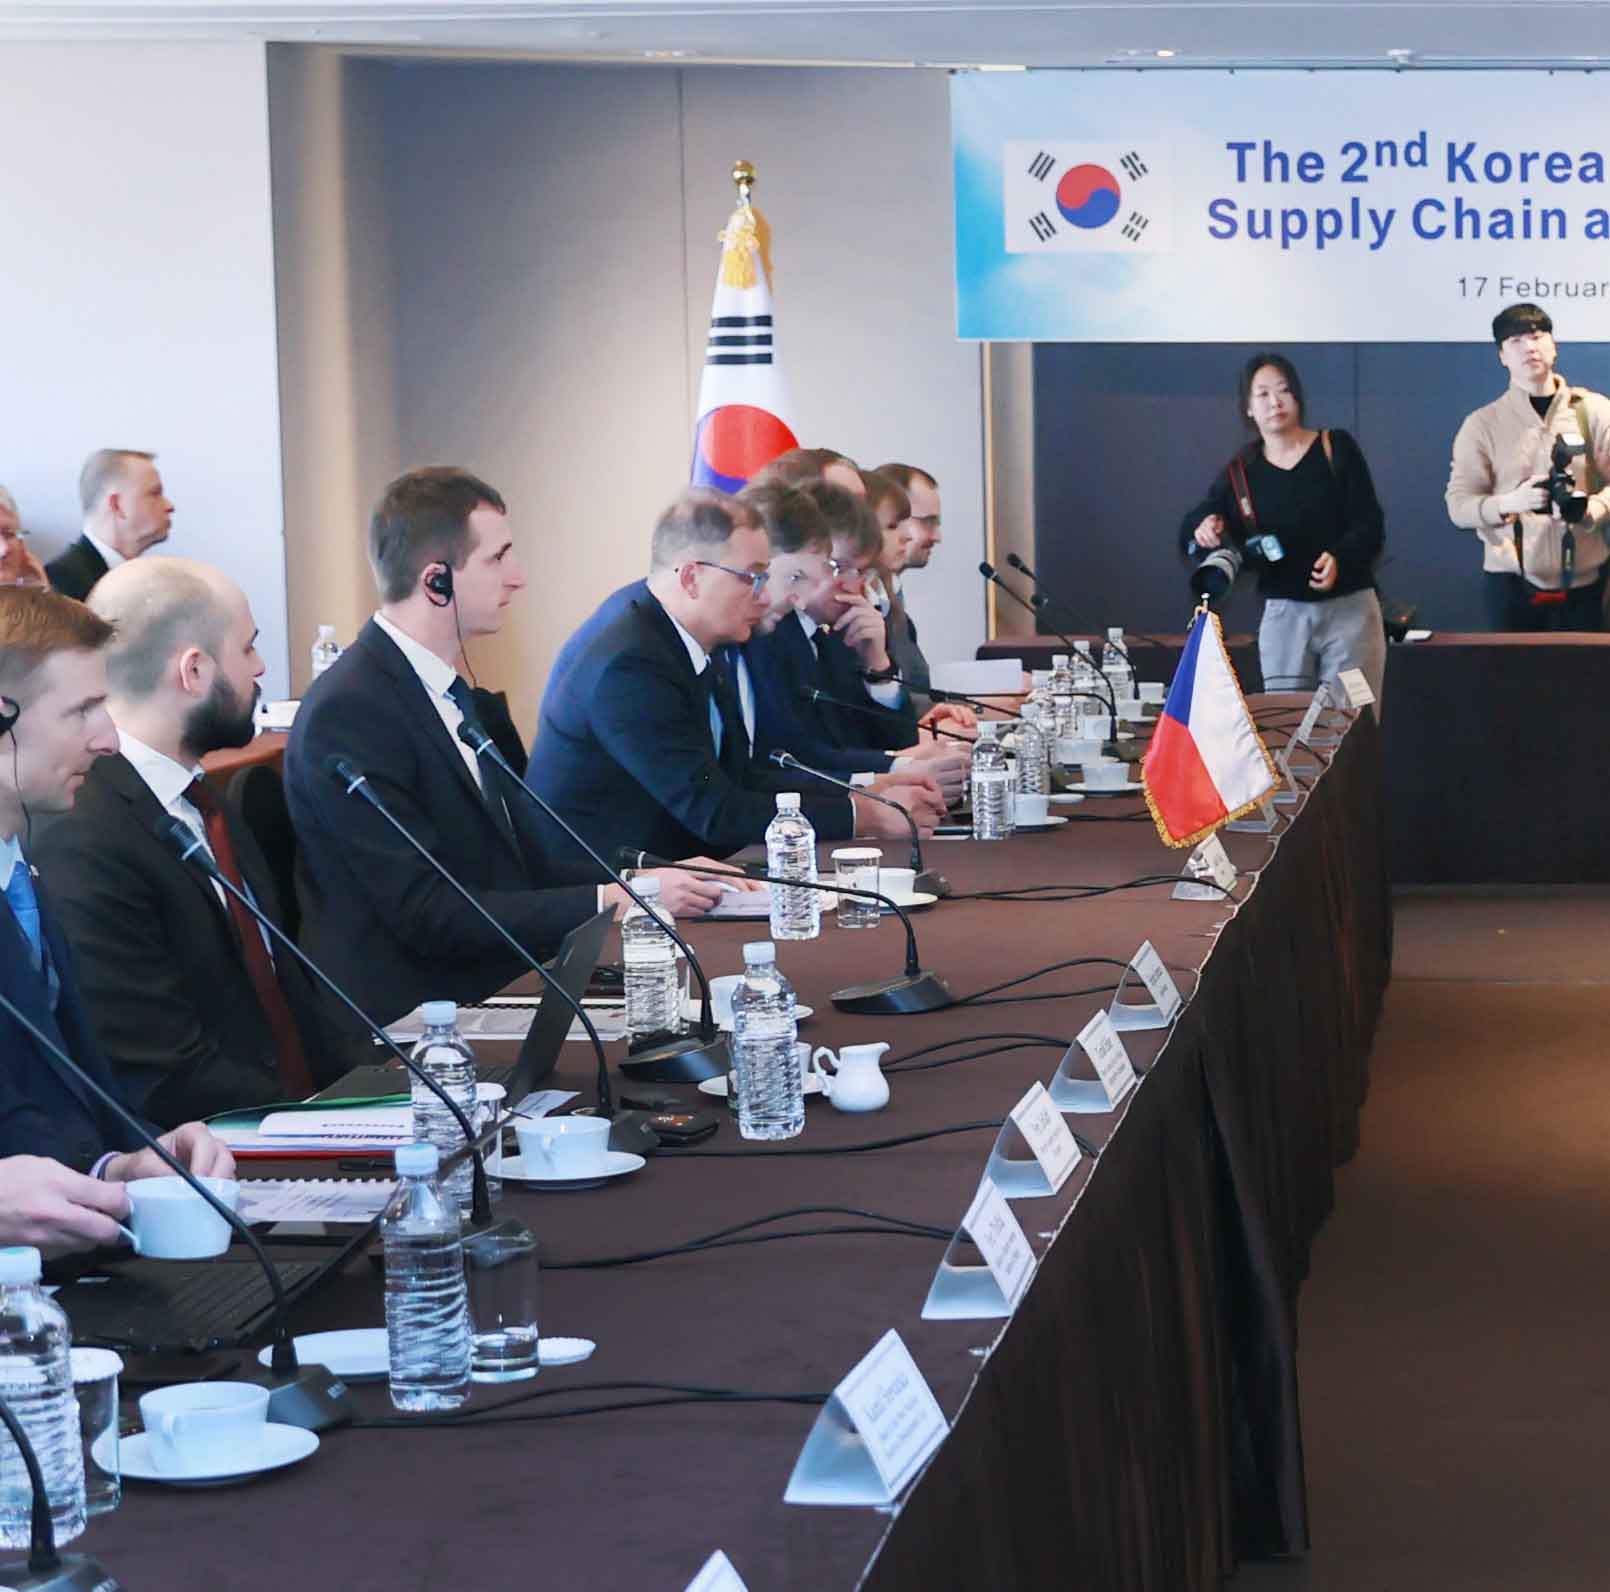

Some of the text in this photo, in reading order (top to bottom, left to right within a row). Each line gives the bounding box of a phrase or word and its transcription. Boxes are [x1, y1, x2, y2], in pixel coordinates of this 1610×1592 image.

[1226, 140, 1324, 183] The
[1341, 131, 1428, 183] 2nd
[1209, 197, 1396, 250] Supply
[1412, 197, 1566, 240] Chain
[1459, 277, 1488, 297] 17
